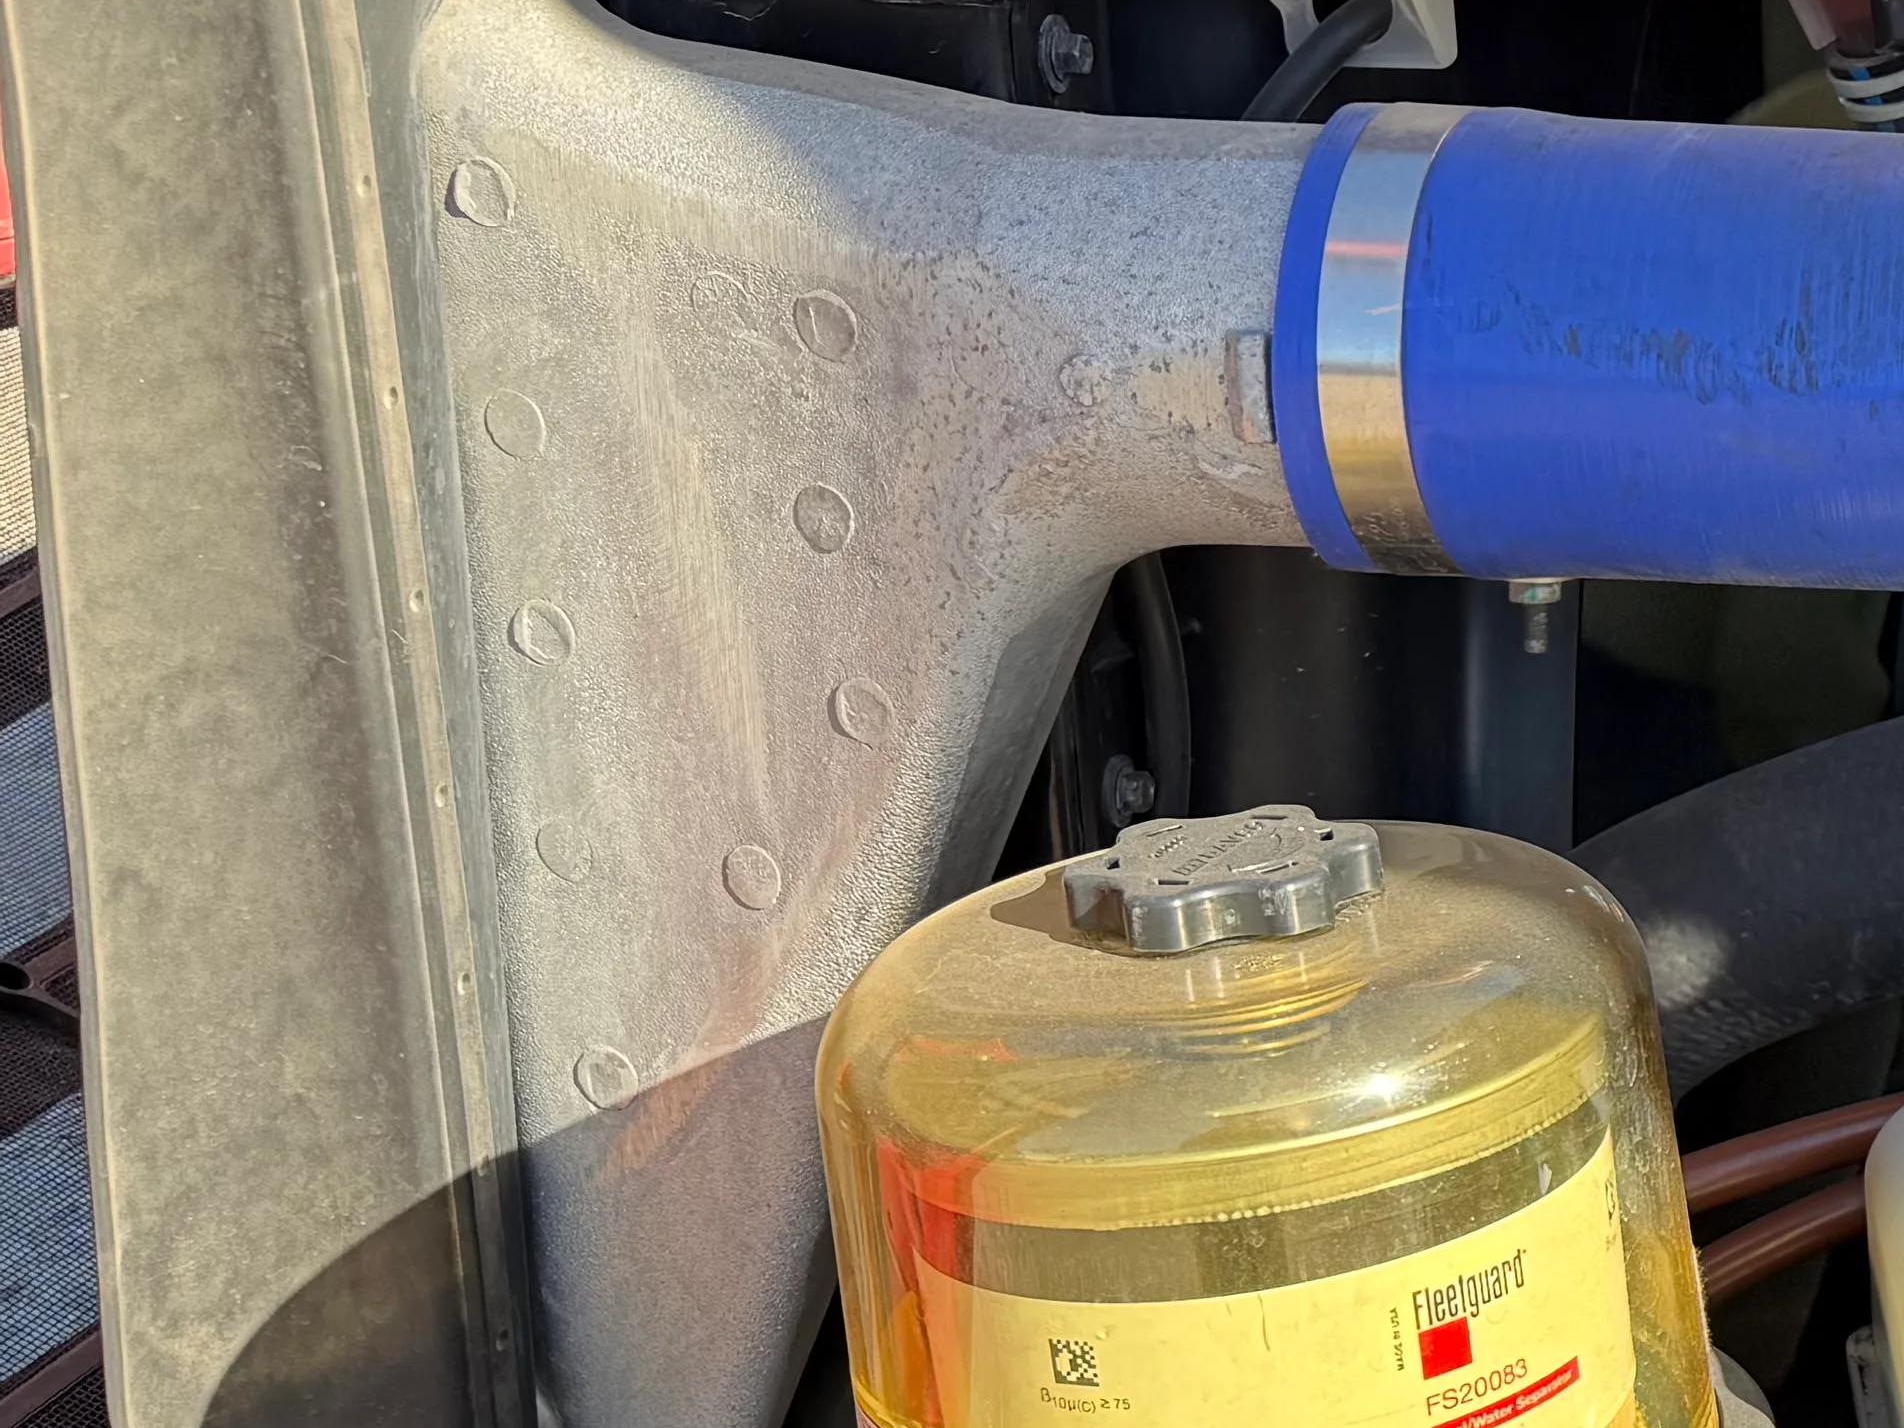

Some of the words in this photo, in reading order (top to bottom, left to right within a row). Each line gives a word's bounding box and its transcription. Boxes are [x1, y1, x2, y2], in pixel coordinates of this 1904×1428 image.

[1411, 1248, 1526, 1331] Fleetguard
[1113, 1397, 1132, 1411] 75
[1426, 1357, 1529, 1417] FS20083
[1515, 1367, 1575, 1411] Separator
